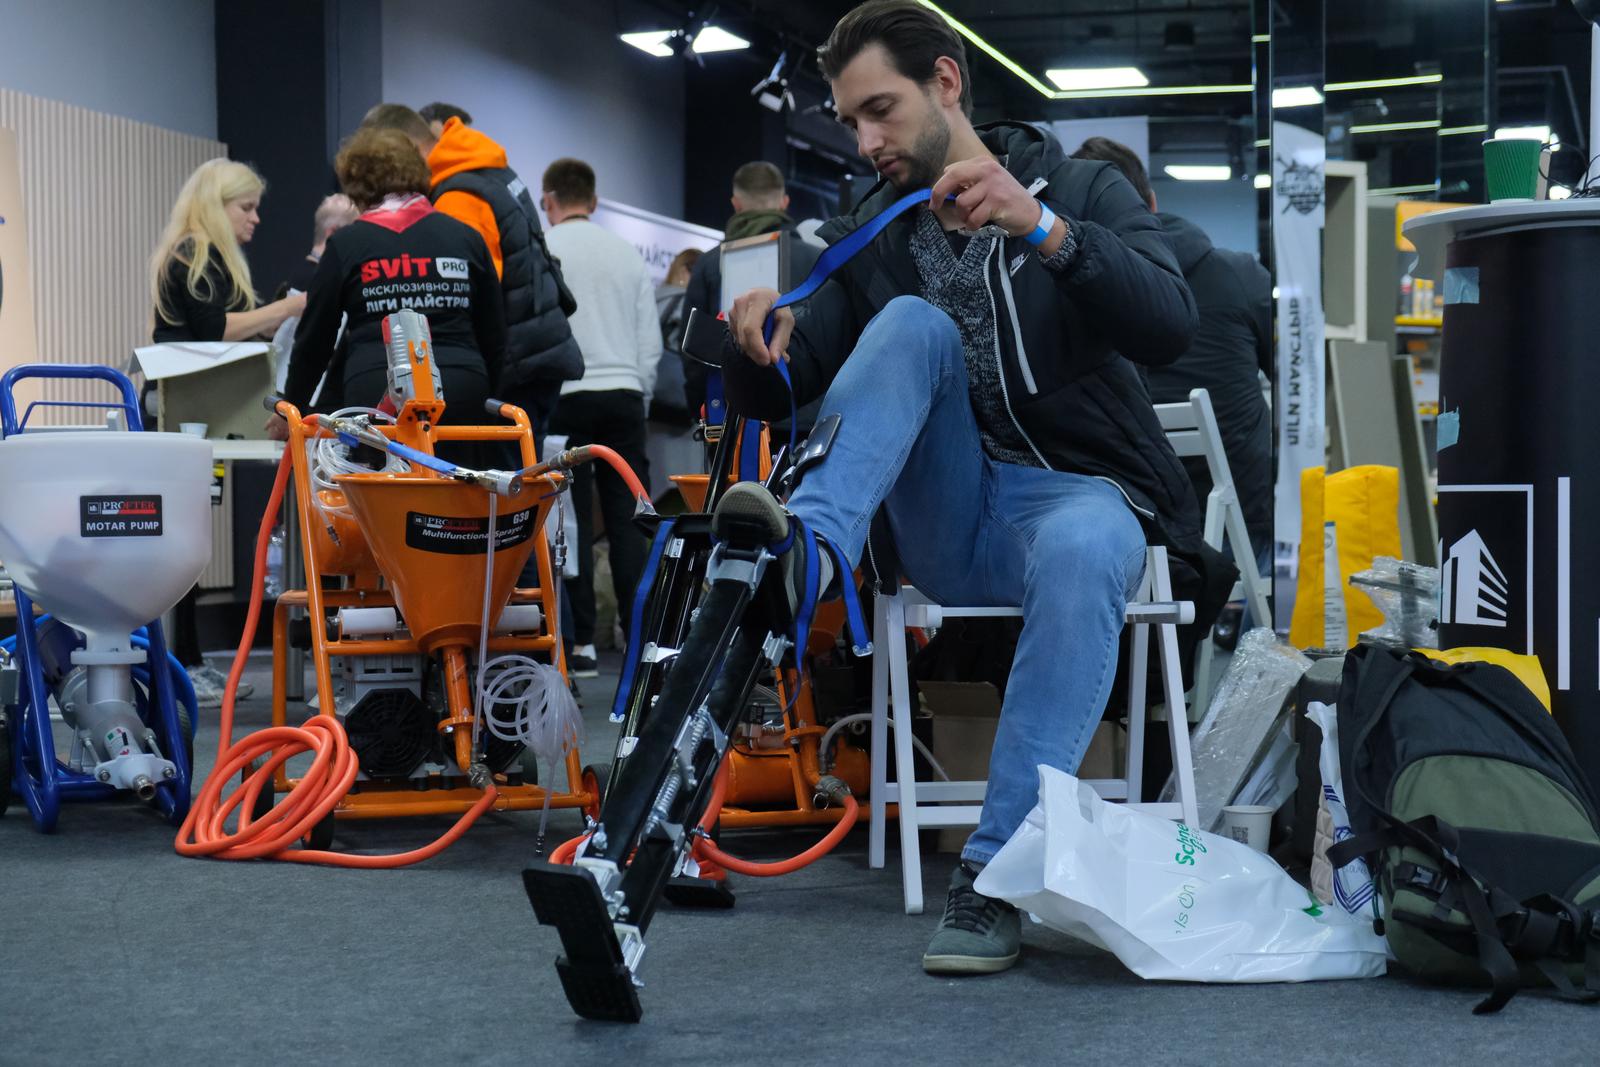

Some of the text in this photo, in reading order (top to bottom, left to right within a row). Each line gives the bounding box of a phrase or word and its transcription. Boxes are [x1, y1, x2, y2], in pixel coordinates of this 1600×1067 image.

[442, 261, 466, 272] PRO
[362, 282, 450, 297] ексклюзивно
[366, 293, 470, 313] ЛІГИ МАЙСТРІВ
[513, 510, 530, 525] G30
[86, 521, 160, 531] MOTAR PUMP
[422, 528, 490, 541] Multifunctiona
[494, 525, 524, 539] Sprayer
